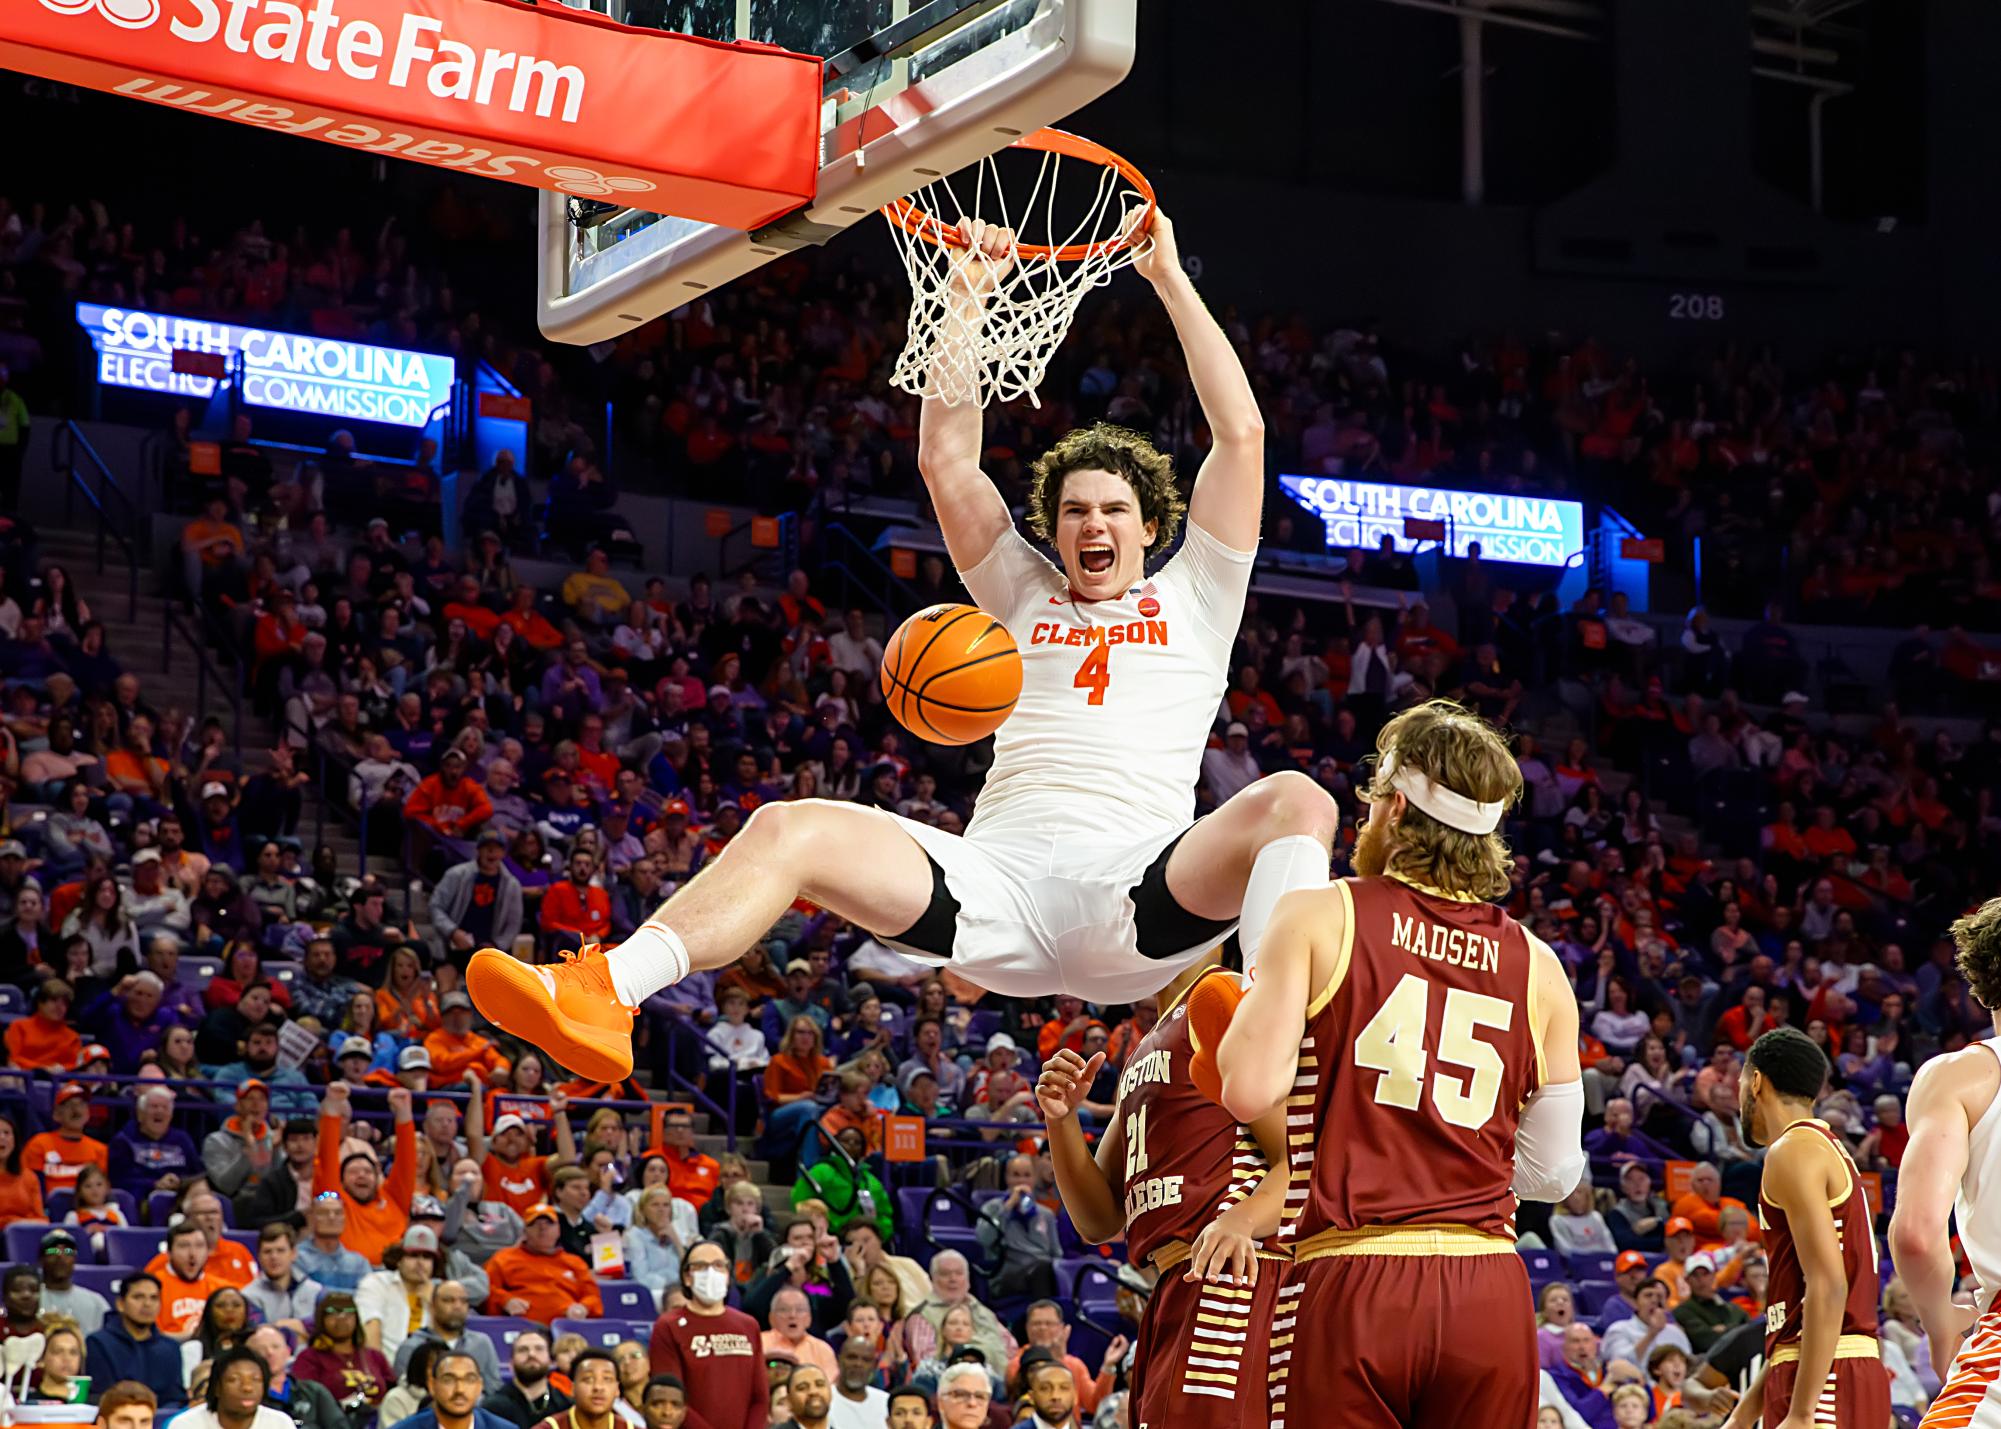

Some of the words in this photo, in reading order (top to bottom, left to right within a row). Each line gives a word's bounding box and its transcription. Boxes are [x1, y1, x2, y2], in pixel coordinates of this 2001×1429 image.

[1670, 294, 1723, 320] 208
[102, 308, 229, 356] SOUTH
[240, 330, 430, 390] CAROLINA
[101, 353, 217, 395] ELECTIO
[243, 375, 431, 423] COMMISSION
[1299, 478, 1401, 517] SOUTH
[1408, 488, 1563, 532] CAROLINA
[1031, 620, 1168, 646] CLEMSON
[1073, 642, 1111, 706] 4
[1391, 912, 1500, 974] MADSEN
[1120, 1049, 1172, 1101] OSTON
[1354, 973, 1514, 1130] 45
[1125, 1103, 1149, 1184] 21
